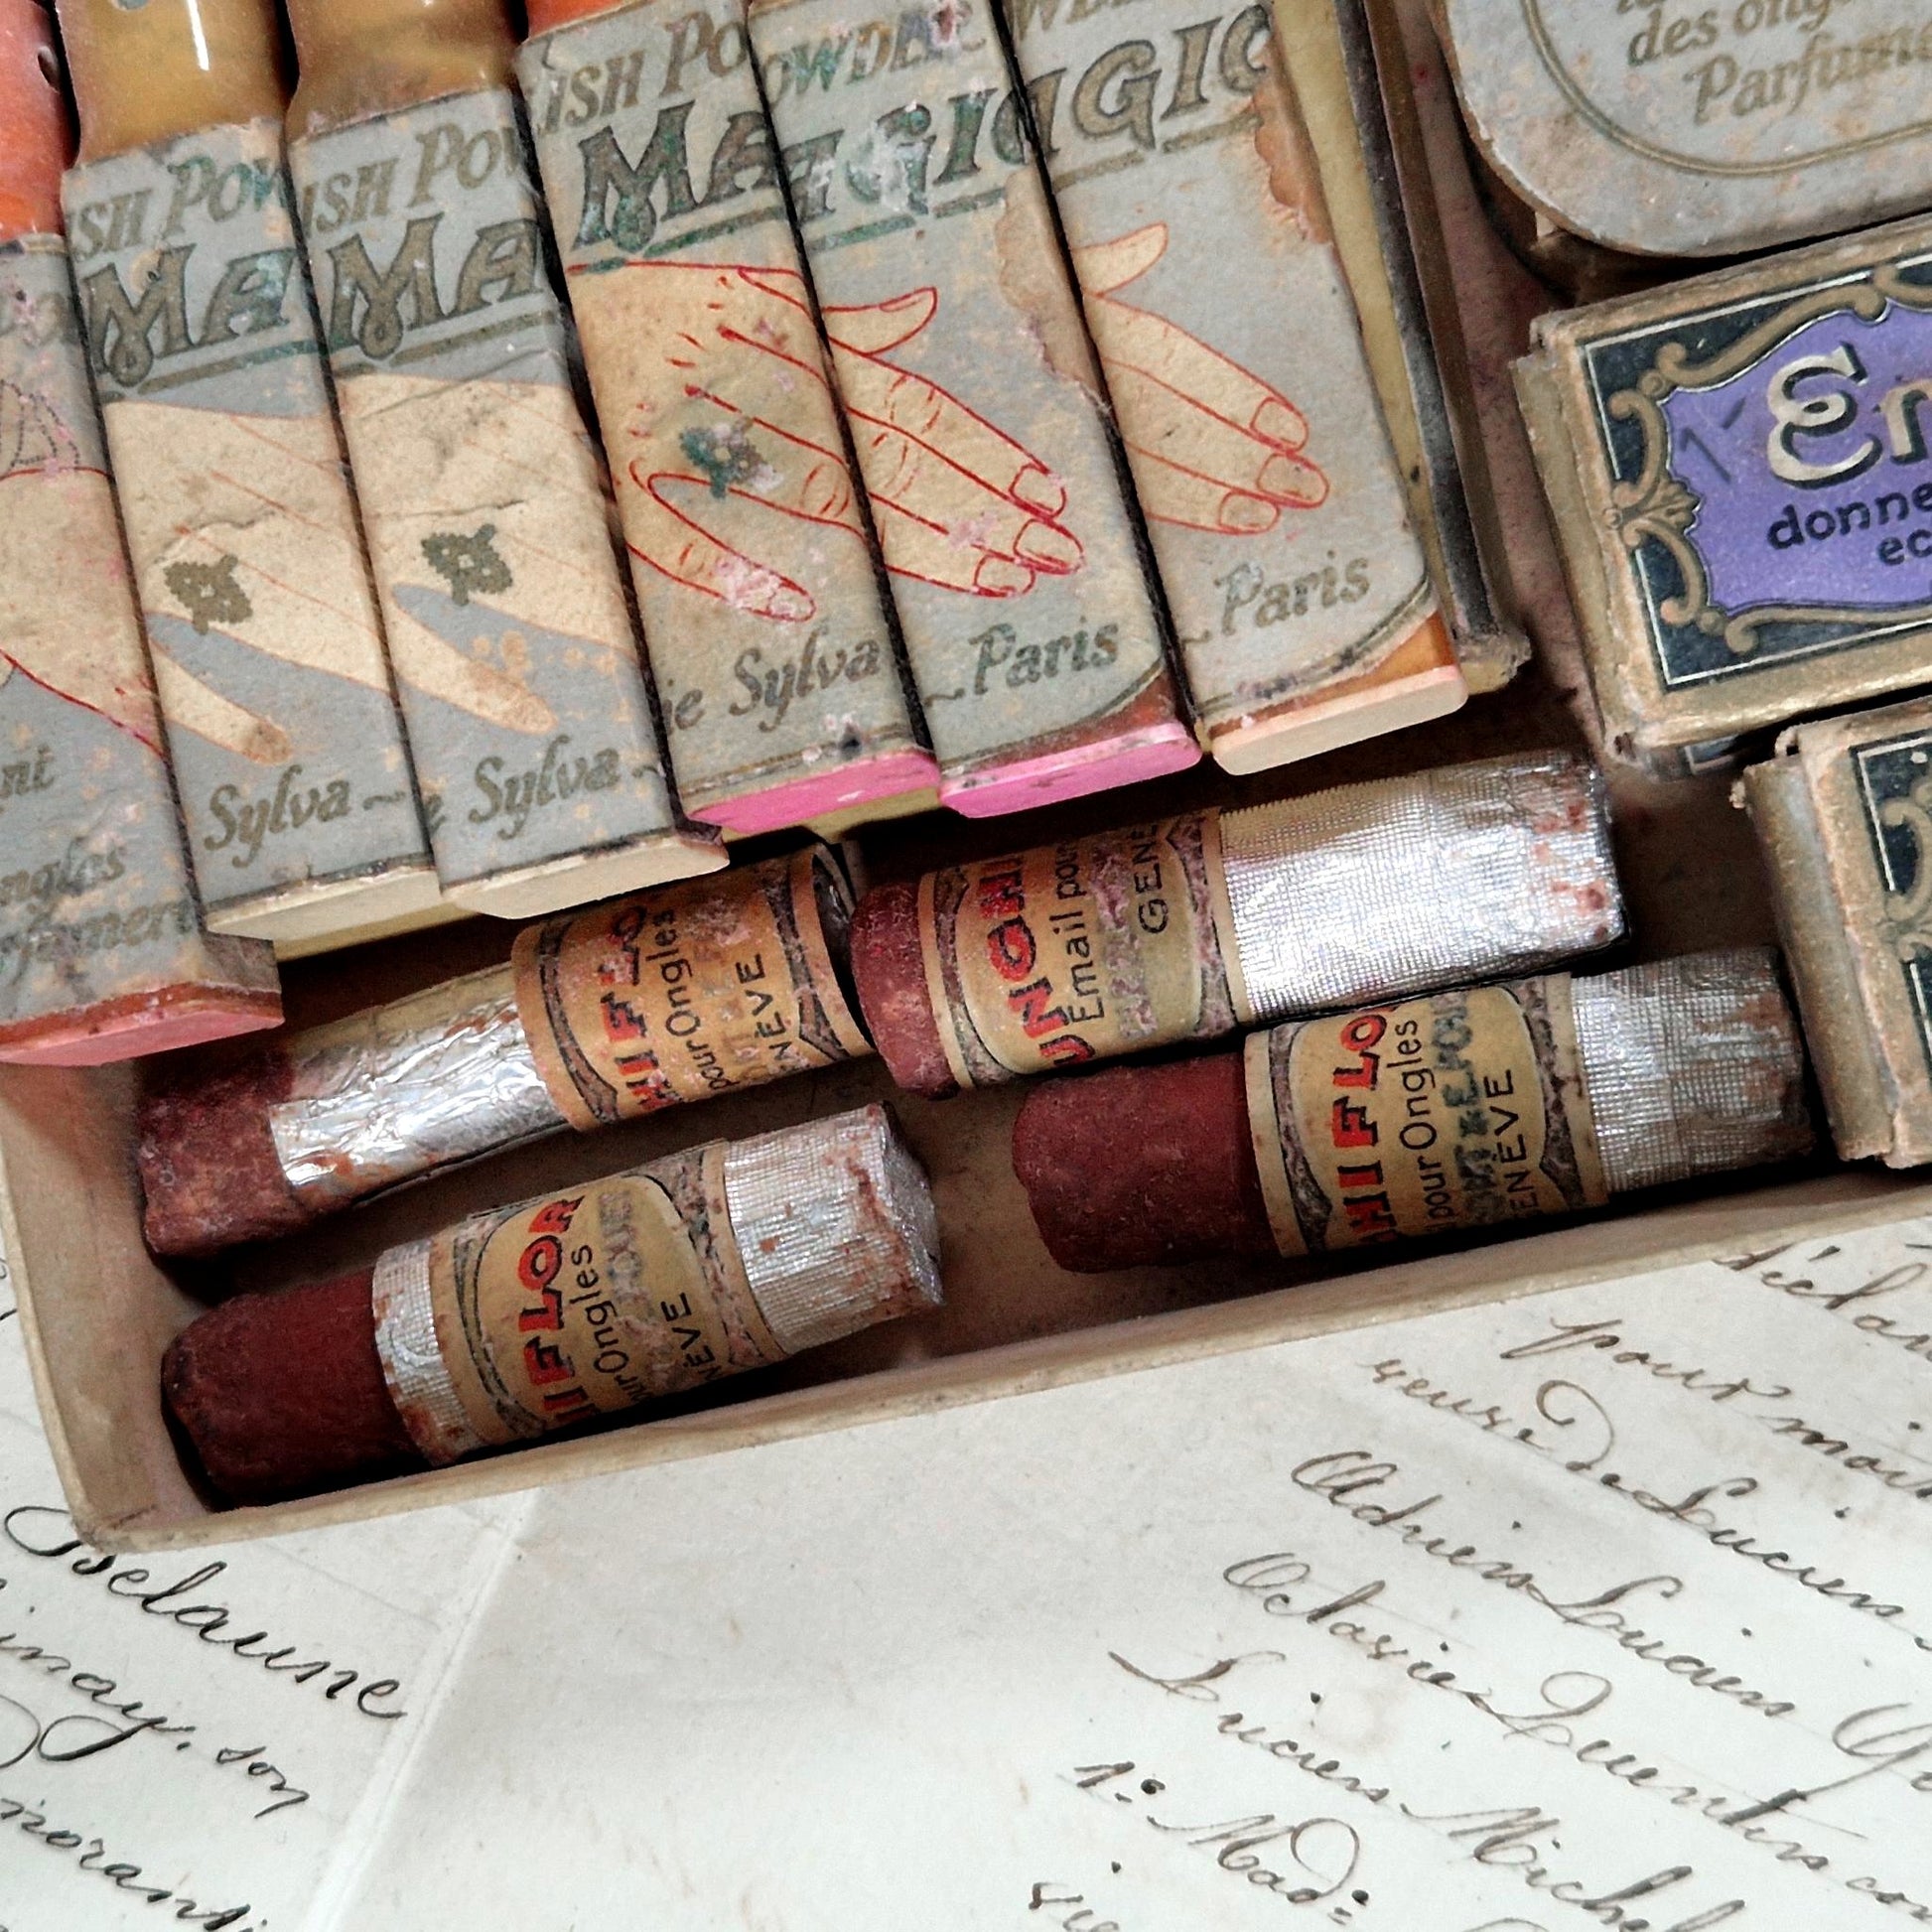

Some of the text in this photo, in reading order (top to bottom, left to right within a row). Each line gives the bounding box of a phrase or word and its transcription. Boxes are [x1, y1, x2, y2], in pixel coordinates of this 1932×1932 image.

[1628, 8, 1720, 69] des
[81, 243, 296, 387] MA
[328, 211, 542, 359] MA
[1214, 550, 1370, 635] Paris
[728, 620, 880, 733] Sylva
[968, 616, 1119, 695] Paris
[203, 763, 351, 869] Sylva
[469, 734, 622, 841] Sylva
[645, 908, 701, 1038] Ongles
[1048, 909, 1105, 1025] Email
[1387, 1019, 1439, 1152] Ongles
[569, 1243, 630, 1374] Ongles
